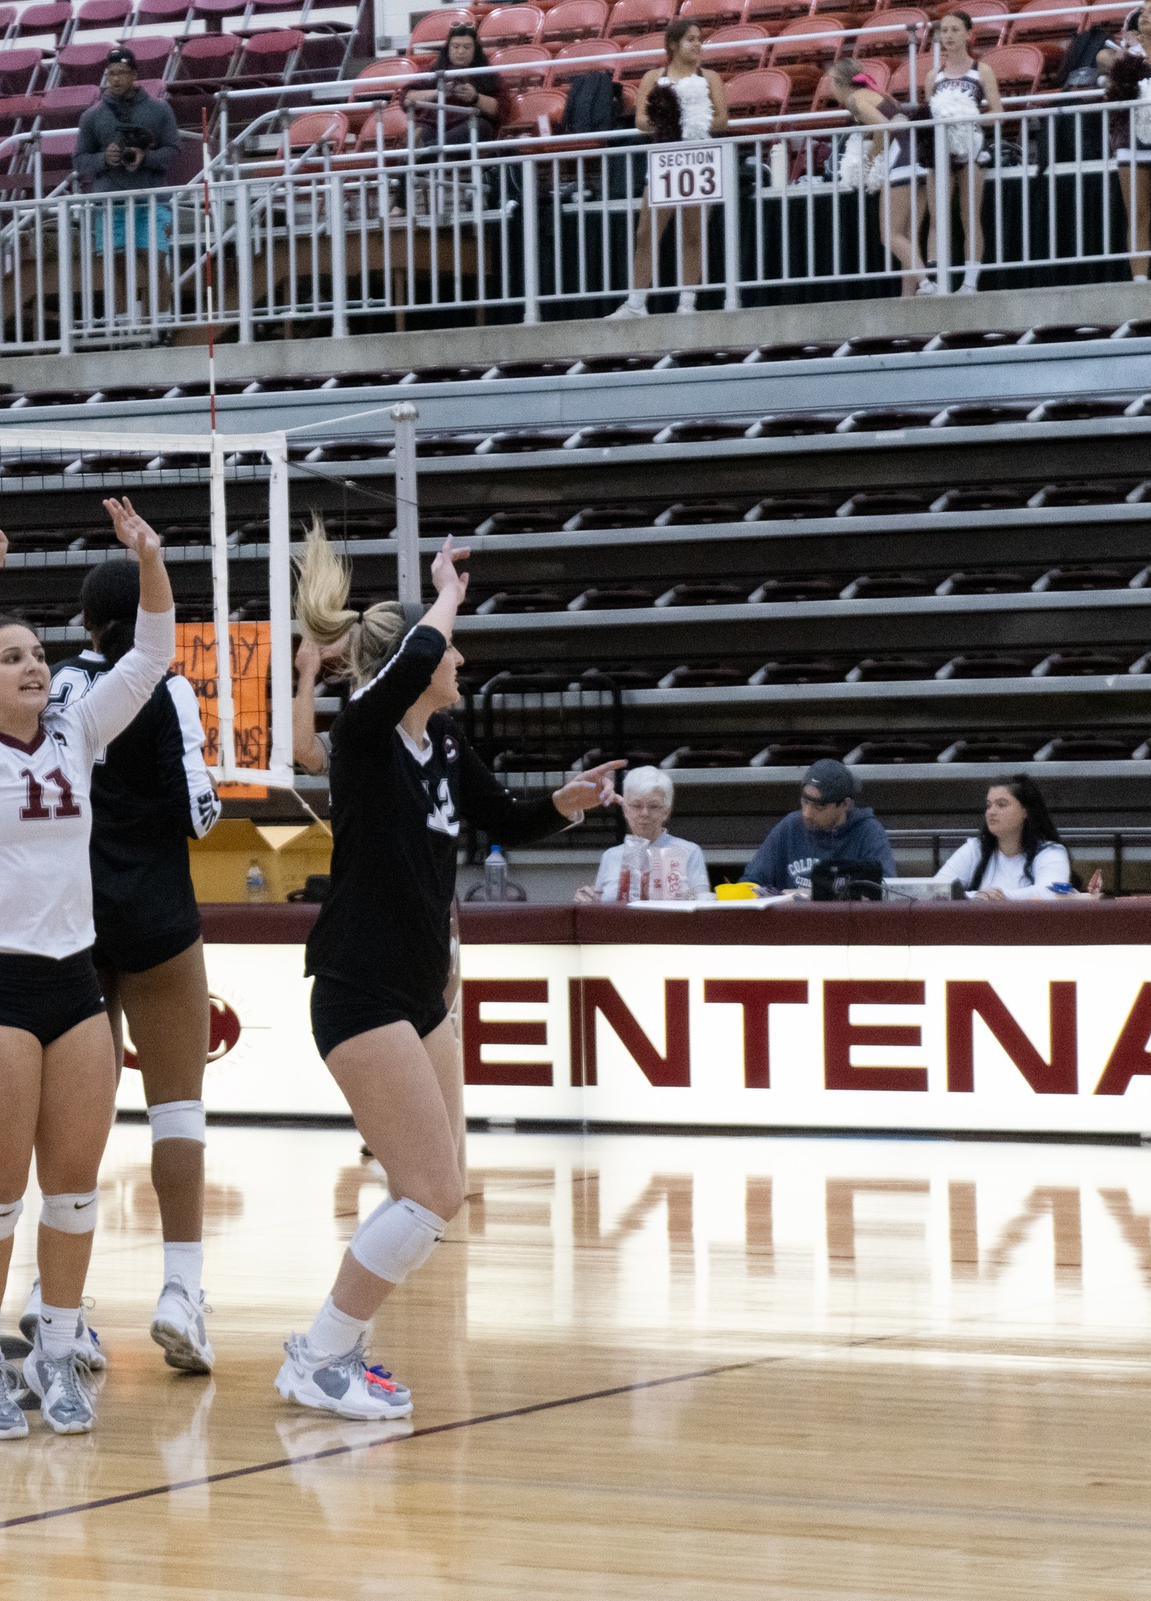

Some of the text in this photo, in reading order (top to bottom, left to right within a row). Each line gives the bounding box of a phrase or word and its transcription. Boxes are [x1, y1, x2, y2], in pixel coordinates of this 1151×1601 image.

[658, 151, 714, 168] SECTION
[659, 166, 717, 199] 103
[19, 765, 82, 821] 11
[461, 976, 1151, 1096] ENTEN
